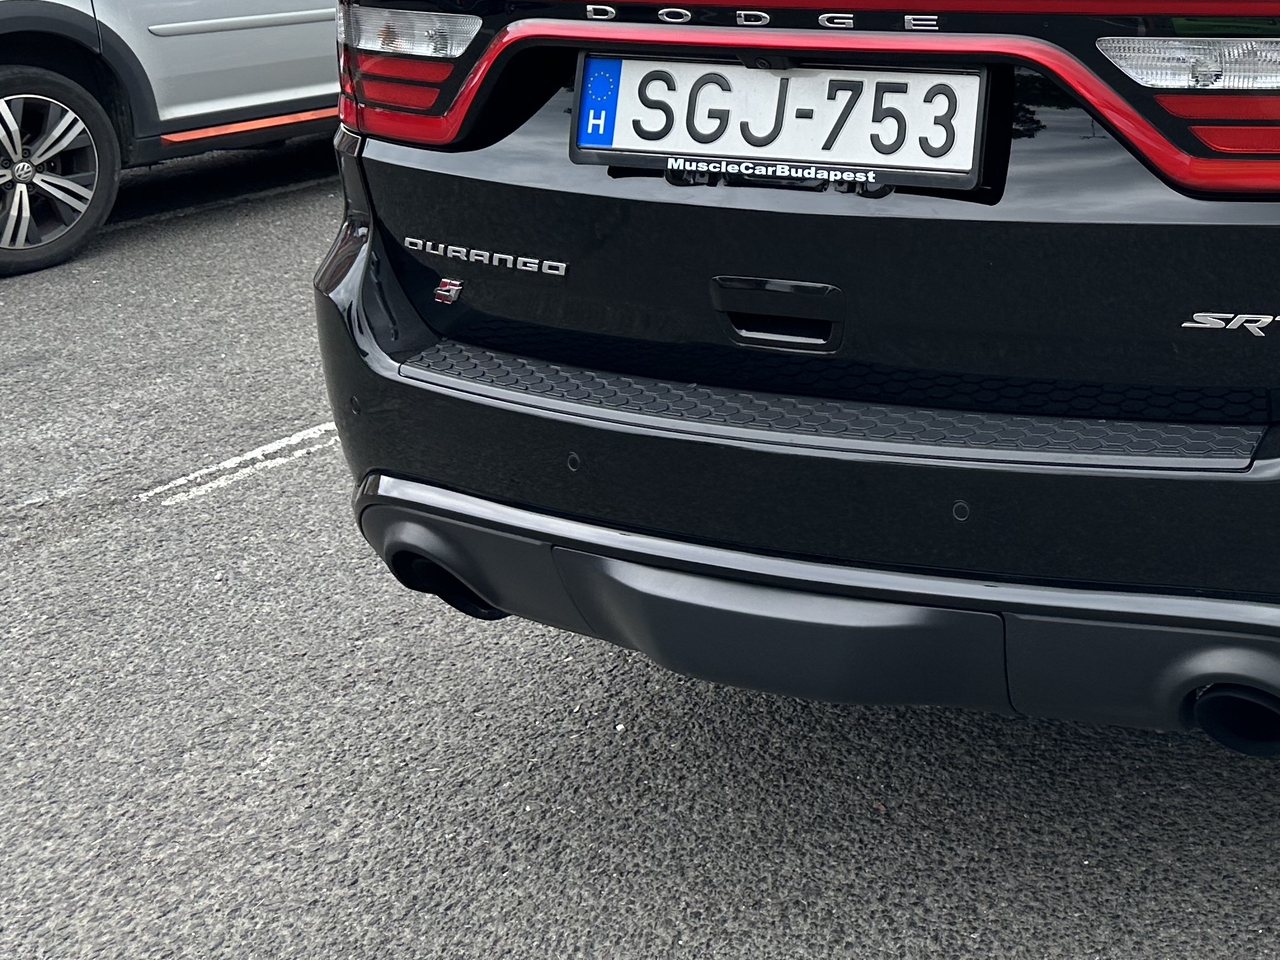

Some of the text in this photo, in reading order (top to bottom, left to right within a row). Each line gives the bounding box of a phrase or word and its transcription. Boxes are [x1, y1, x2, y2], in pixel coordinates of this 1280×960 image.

[586, 4, 939, 30] DODGE
[587, 70, 958, 158] H SGJ-753
[667, 157, 876, 183] MuscleCarBudapest
[404, 237, 568, 276] DURANGO
